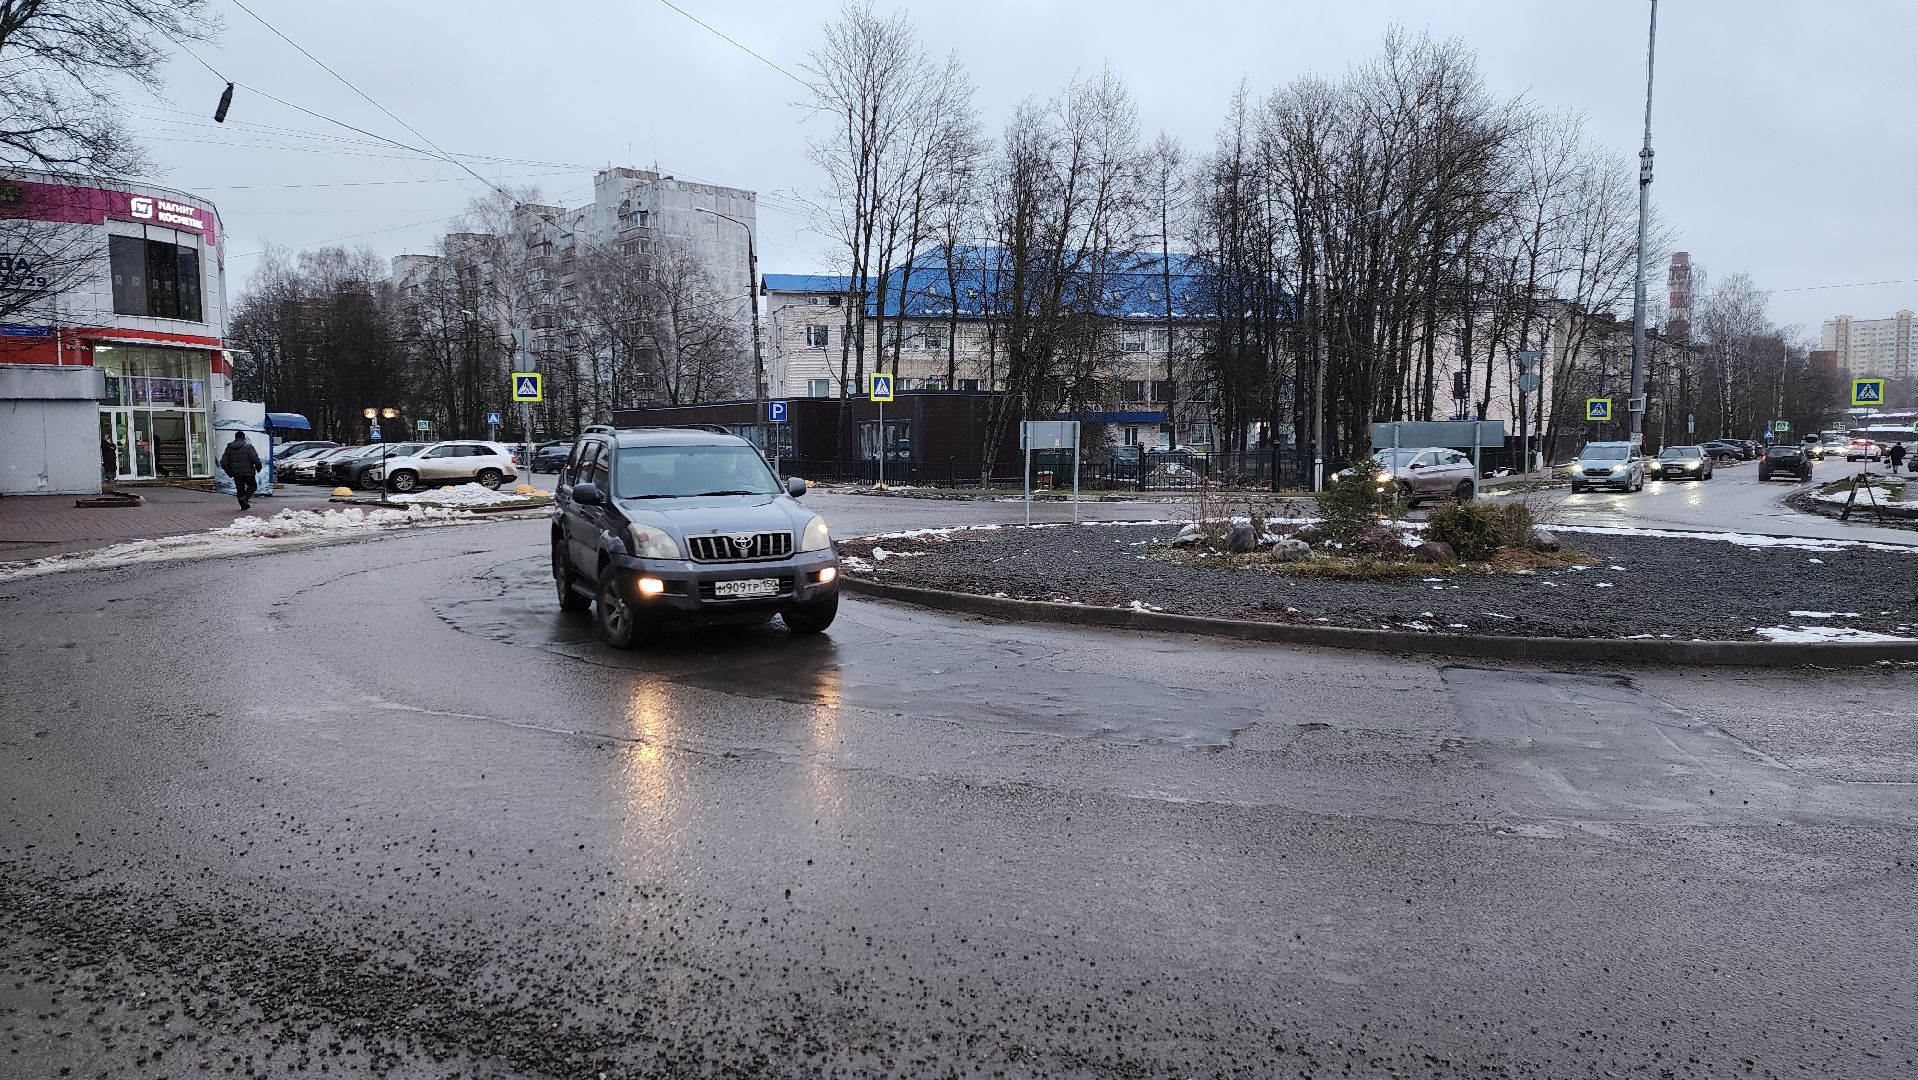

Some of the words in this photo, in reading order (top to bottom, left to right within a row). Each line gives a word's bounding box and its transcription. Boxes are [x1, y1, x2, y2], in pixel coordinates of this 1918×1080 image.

[158, 200, 194, 215] МАГНИТ
[158, 212, 204, 229] КОСМЕТИК
[26, 276, 47, 287] 29
[772, 403, 784, 419] P
